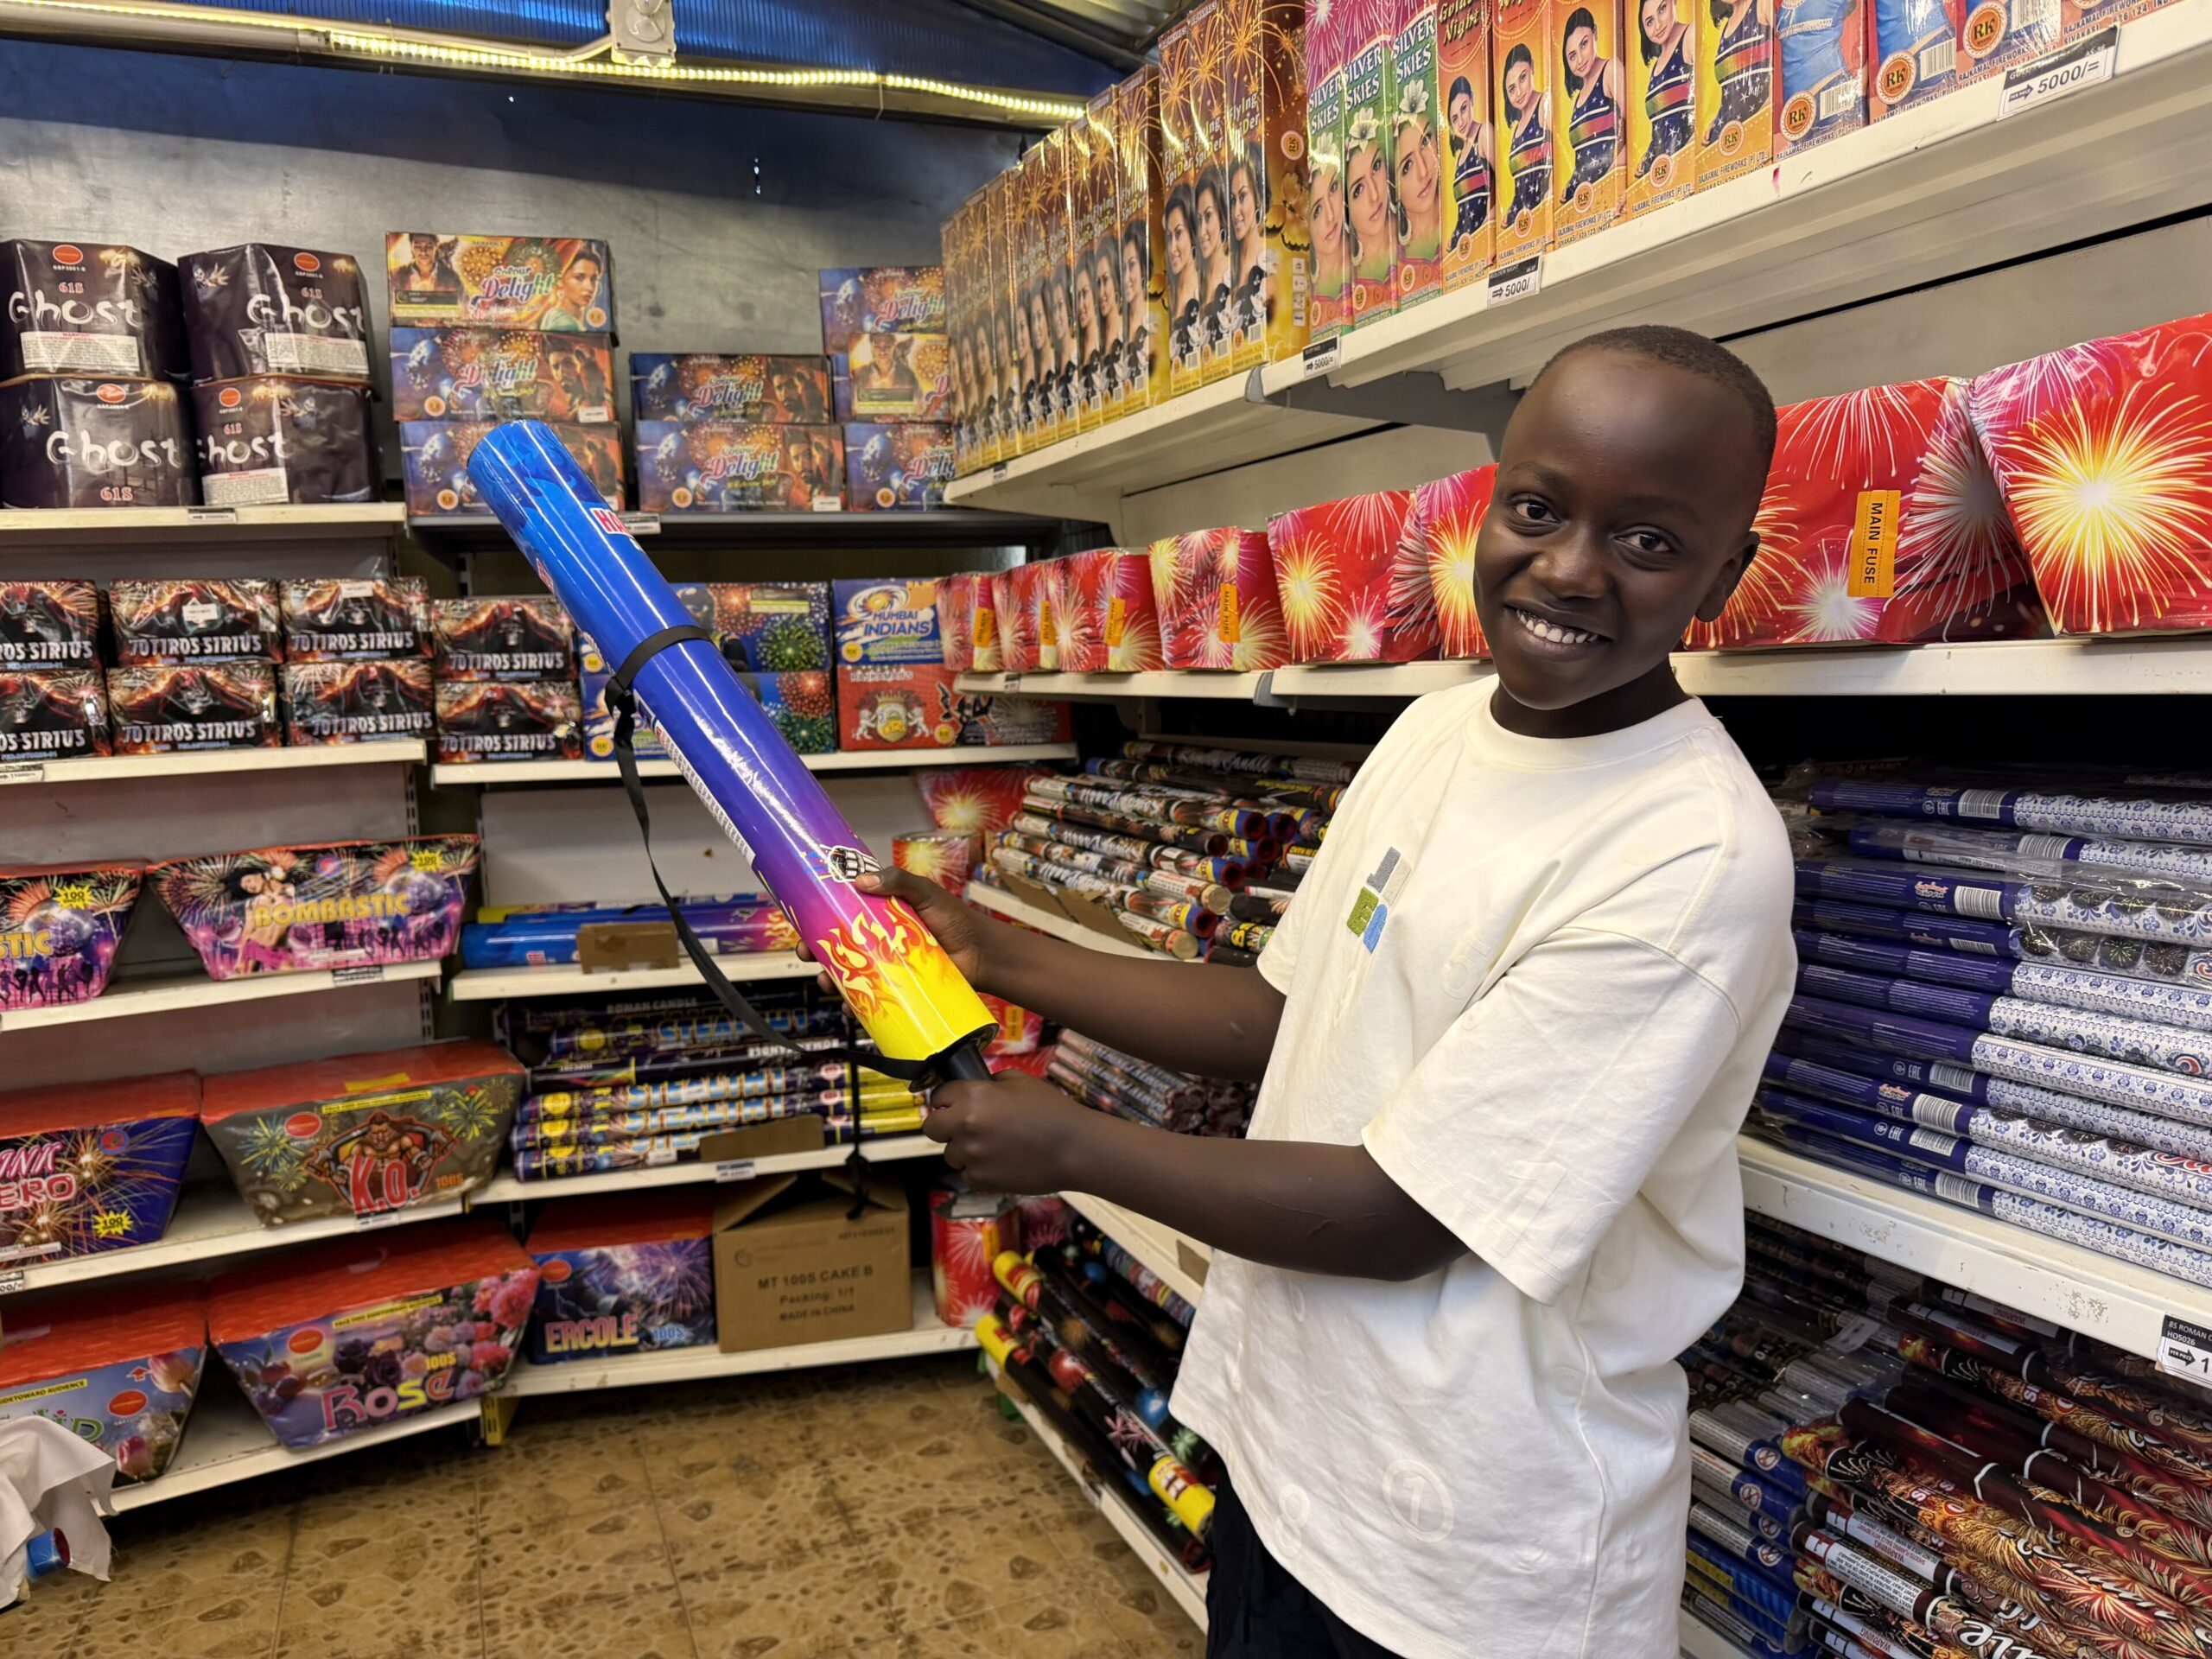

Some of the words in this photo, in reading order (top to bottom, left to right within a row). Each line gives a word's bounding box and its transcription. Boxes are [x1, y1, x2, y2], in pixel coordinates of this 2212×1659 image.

[1392, 14, 1436, 60] SILVER
[1395, 45, 1432, 83] SKIES
[2037, 60, 2100, 94] 5000/=
[1308, 75, 1342, 112] SILVER
[1346, 73, 1380, 111] SKIES
[1311, 101, 1339, 134] SKIES
[59, 282, 84, 295] 61S
[9, 289, 143, 327] Ghost
[246, 294, 364, 330] Ghost
[47, 430, 181, 473] Ghost
[198, 430, 294, 466] host
[101, 486, 133, 501] 61S
[1868, 501, 1884, 541] MAIN
[1864, 548, 1878, 586] FUSE
[873, 611, 918, 621] MUMBAI
[864, 621, 932, 636] INDIANS
[29, 641, 93, 660] SIRIUS
[204, 634, 262, 653] SIRIUS
[359, 631, 414, 649] SIRIUS
[512, 652, 564, 670] SIRIUS
[197, 721, 256, 741] SIRIUS
[377, 711, 433, 732] SIRIUS
[21, 729, 86, 750] SIRIUS
[504, 734, 556, 751] SIRIUS
[254, 892, 411, 928] BOMBASTIC
[607, 1000, 650, 1014] ROMAN
[653, 997, 698, 1011] CANDLE
[351, 1154, 420, 1214] K.O.
[435, 1173, 464, 1188] 100S
[759, 1276, 778, 1290] MT
[783, 1272, 817, 1286] 100S
[820, 1266, 859, 1282] CAKE
[779, 1309, 807, 1321] MADE
[810, 1307, 821, 1317] IN
[823, 1305, 855, 1316] CHINA
[545, 1315, 639, 1353] ERCOLE
[652, 1323, 685, 1342] 100S
[2168, 1321, 2177, 1330] 8S
[2178, 1325, 2207, 1339] ROMAN
[425, 1351, 457, 1371] 100S
